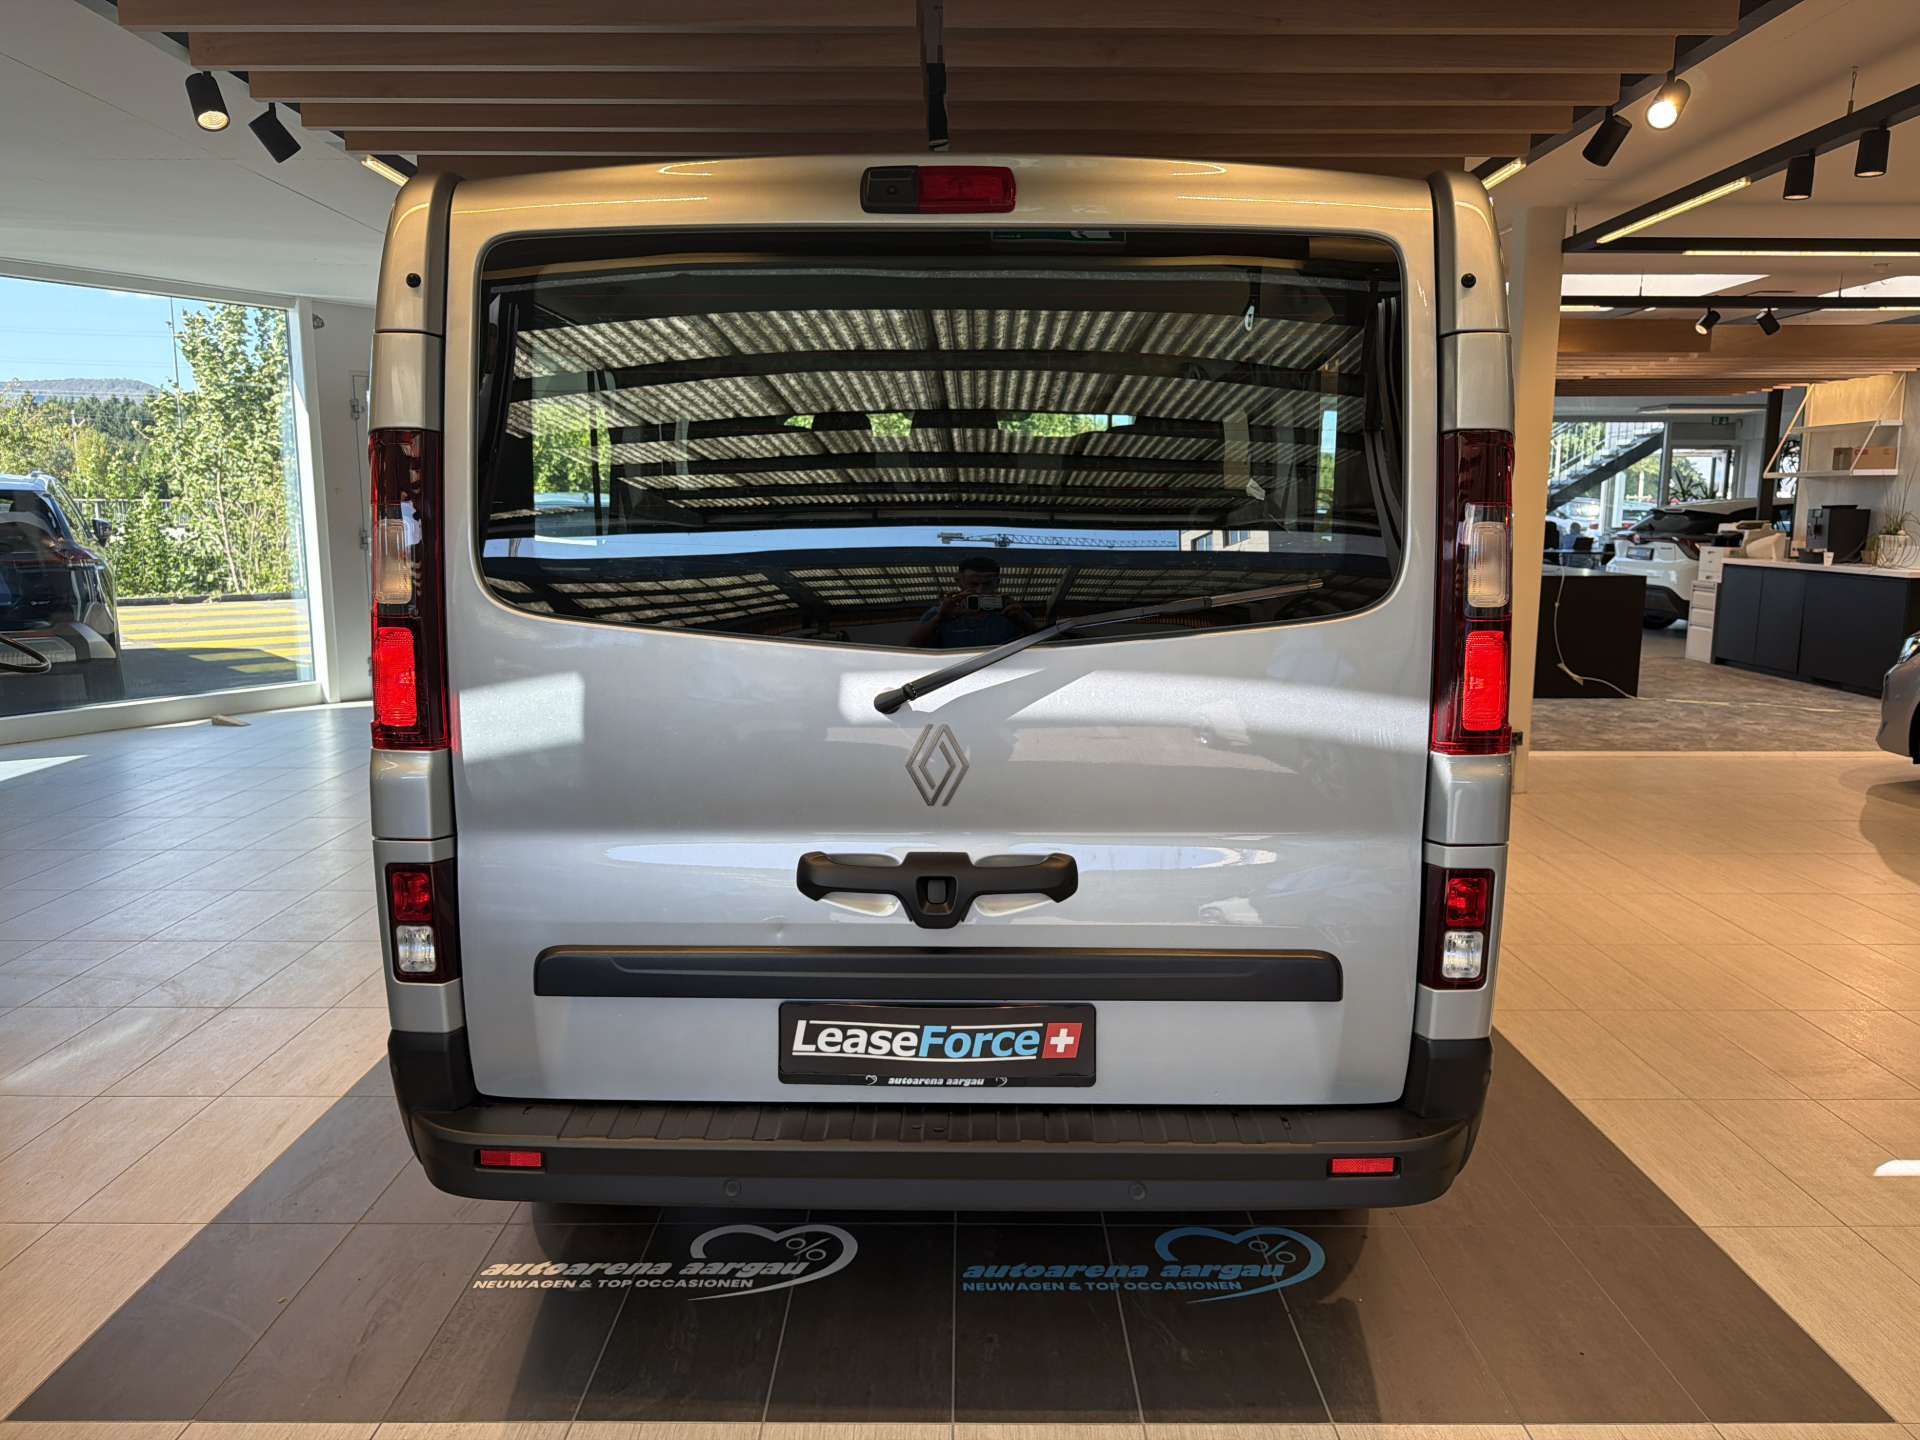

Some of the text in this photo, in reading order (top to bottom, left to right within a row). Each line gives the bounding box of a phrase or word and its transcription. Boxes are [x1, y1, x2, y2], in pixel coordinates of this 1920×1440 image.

[792, 1020, 1039, 1058] LeaseForce
[888, 1076, 985, 1087] autoarena aargau
[480, 1261, 810, 1278] autoarena aargau
[962, 1263, 1287, 1280] autoarena aargau
[473, 1278, 754, 1289] NEUWAGEN & TOP OCCASIONEN
[963, 1281, 1243, 1292] NEUWAGEN & TOP OCCASIONEN
